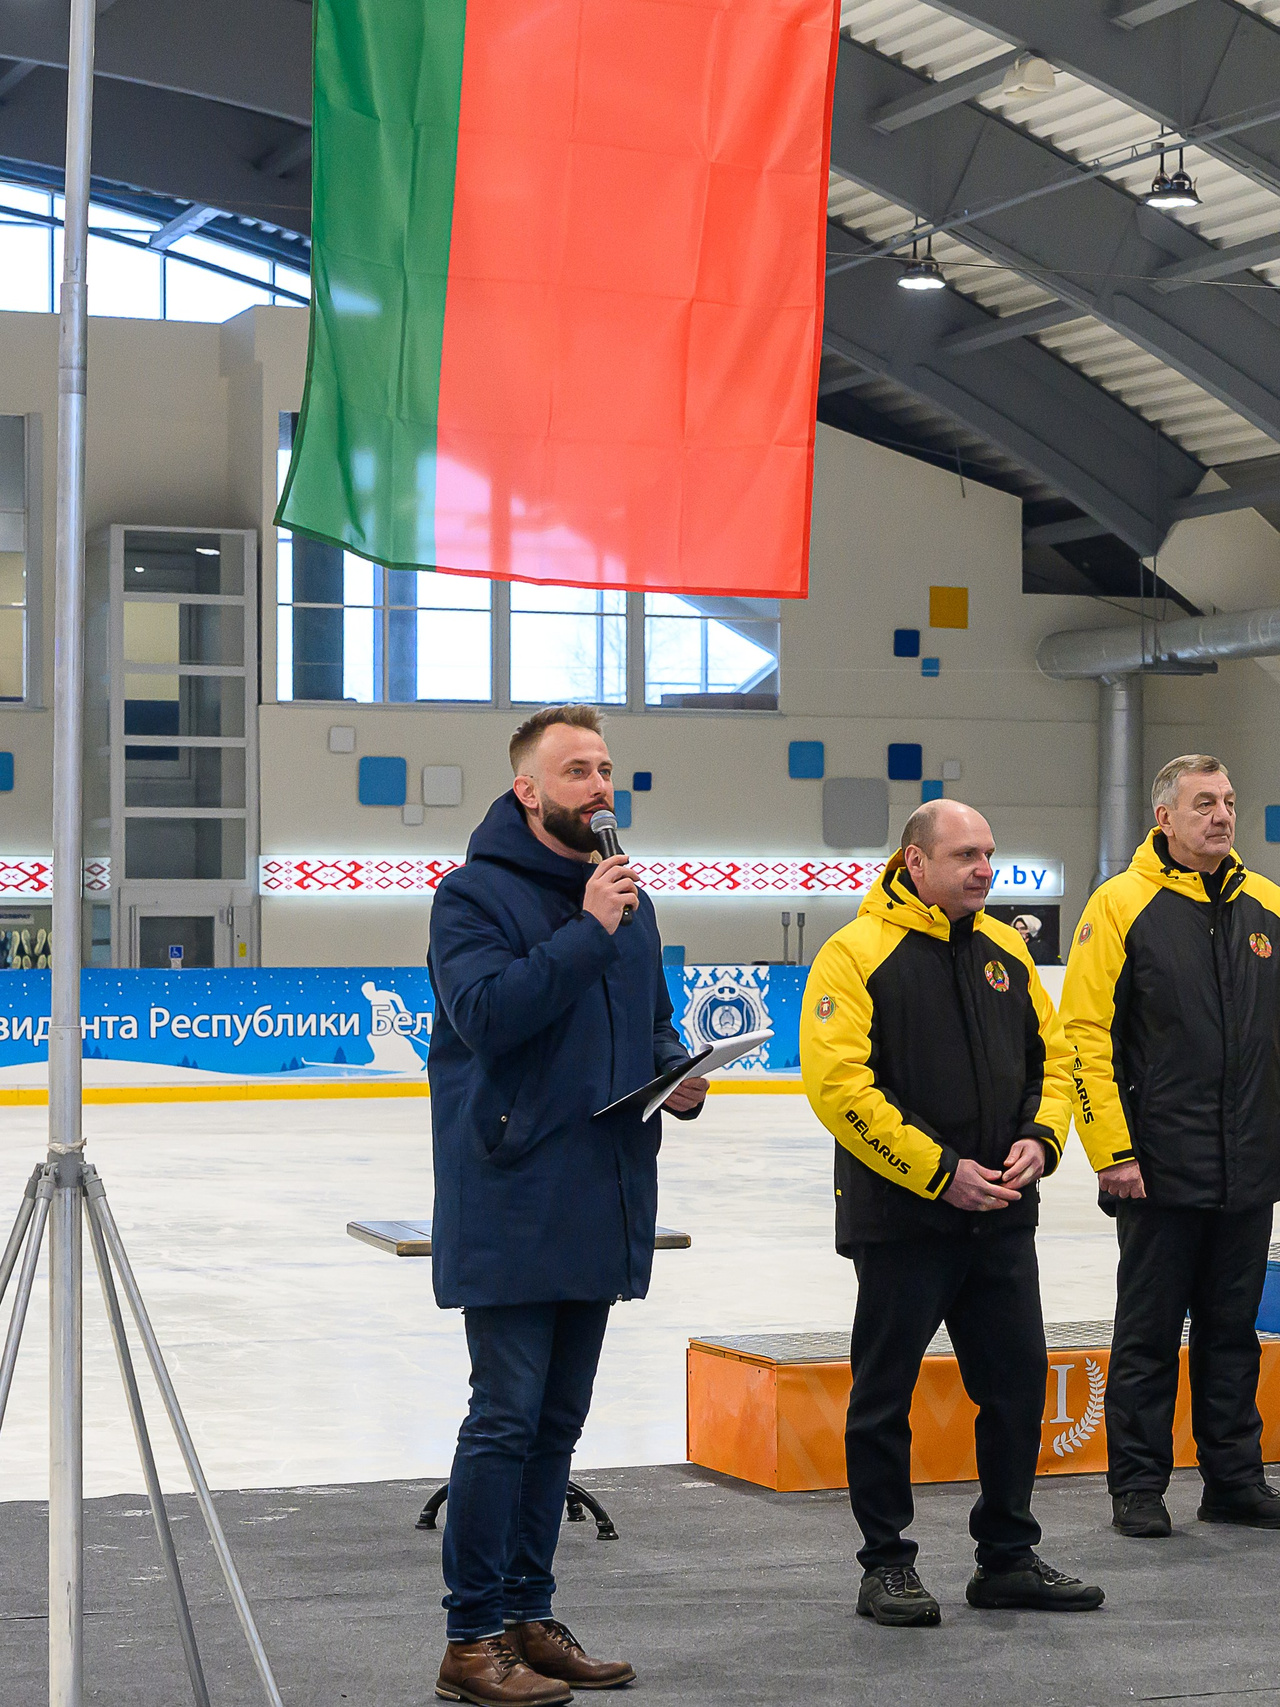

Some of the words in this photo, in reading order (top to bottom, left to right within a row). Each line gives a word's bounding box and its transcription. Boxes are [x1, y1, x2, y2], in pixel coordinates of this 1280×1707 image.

[0, 1014, 139, 1046] зиднта
[150, 1006, 360, 1046] Республики
[1072, 1045, 1095, 1125] ELARUS
[845, 1109, 912, 1175] BELARUS
[1048, 1363, 1075, 1424] I
